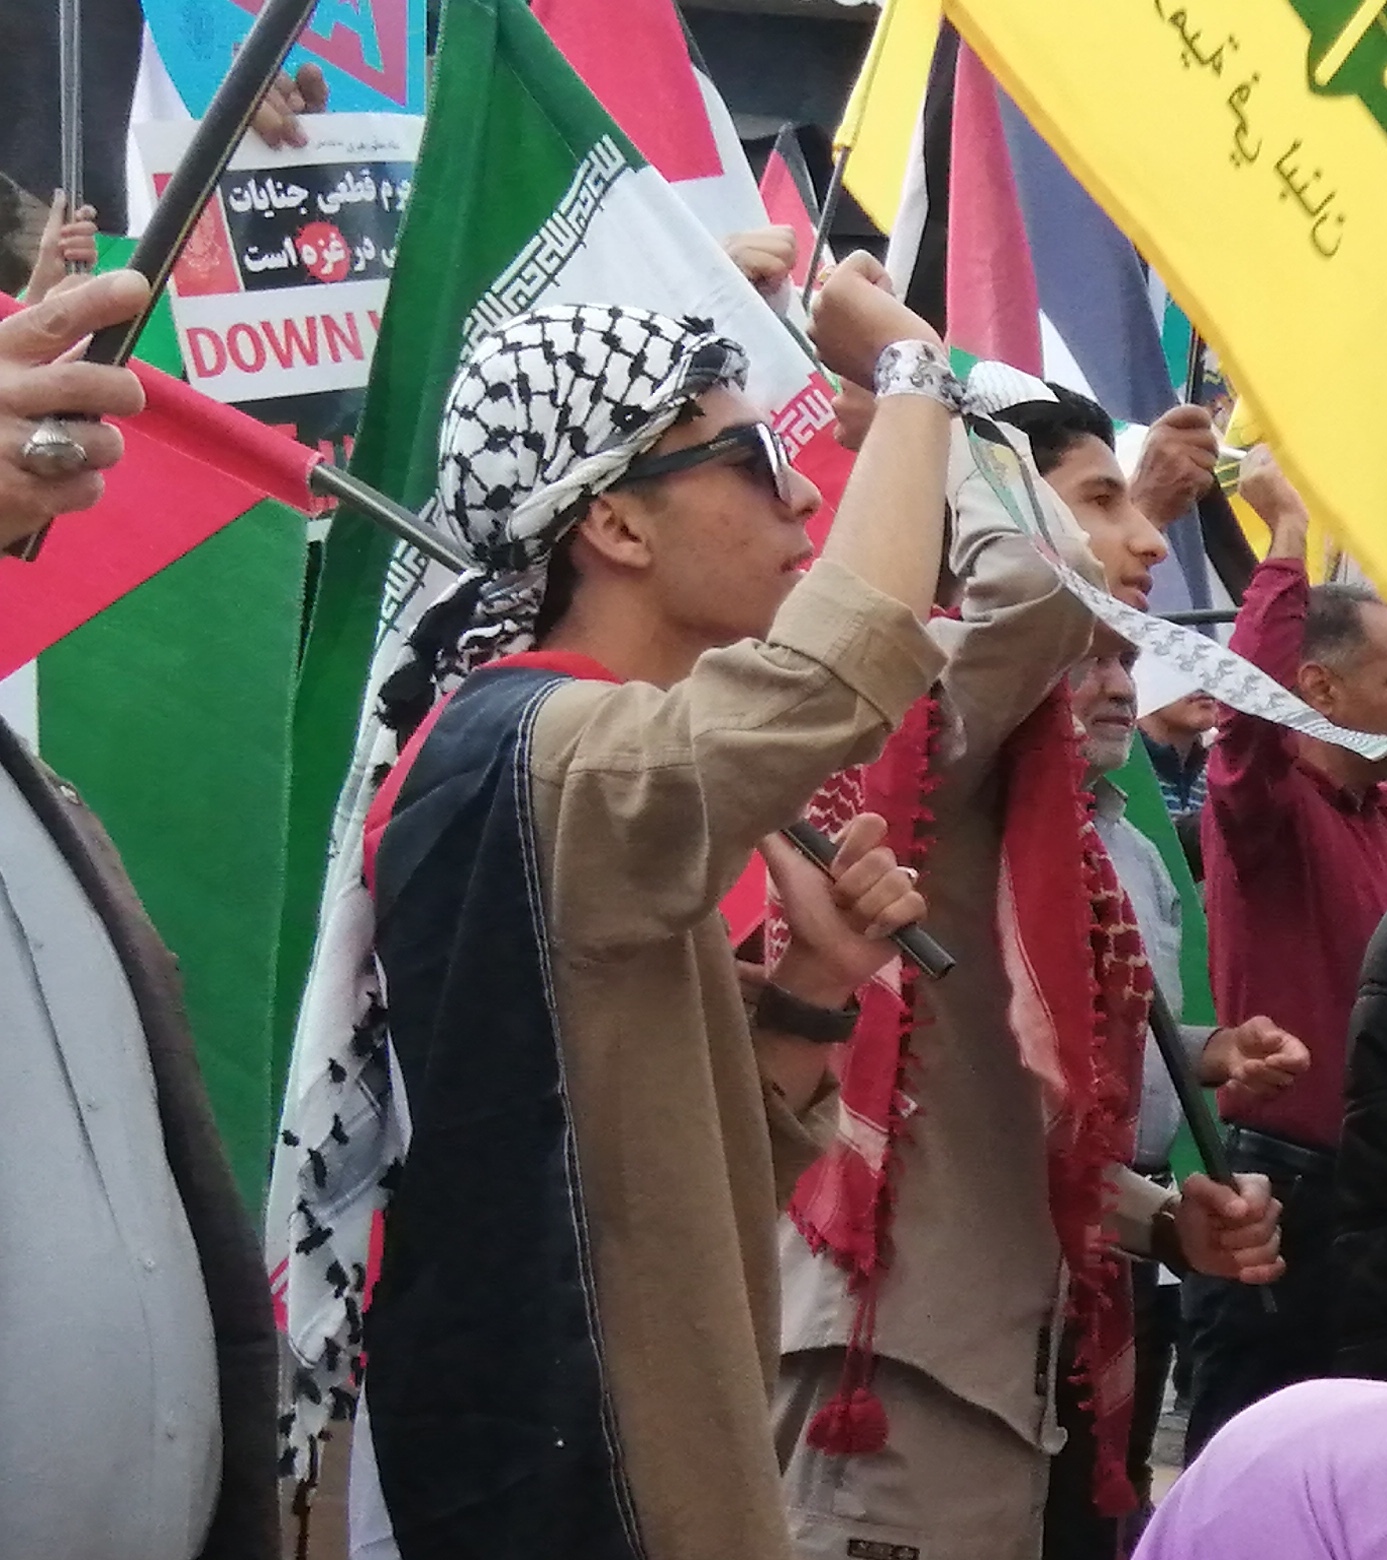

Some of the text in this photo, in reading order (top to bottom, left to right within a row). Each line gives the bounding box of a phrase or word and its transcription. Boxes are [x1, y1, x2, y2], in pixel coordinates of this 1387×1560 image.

[228, 177, 310, 218] جنایات
[244, 236, 298, 273] است
[302, 232, 345, 275] غزه
[354, 236, 375, 272] در
[186, 311, 364, 379] DOWN
